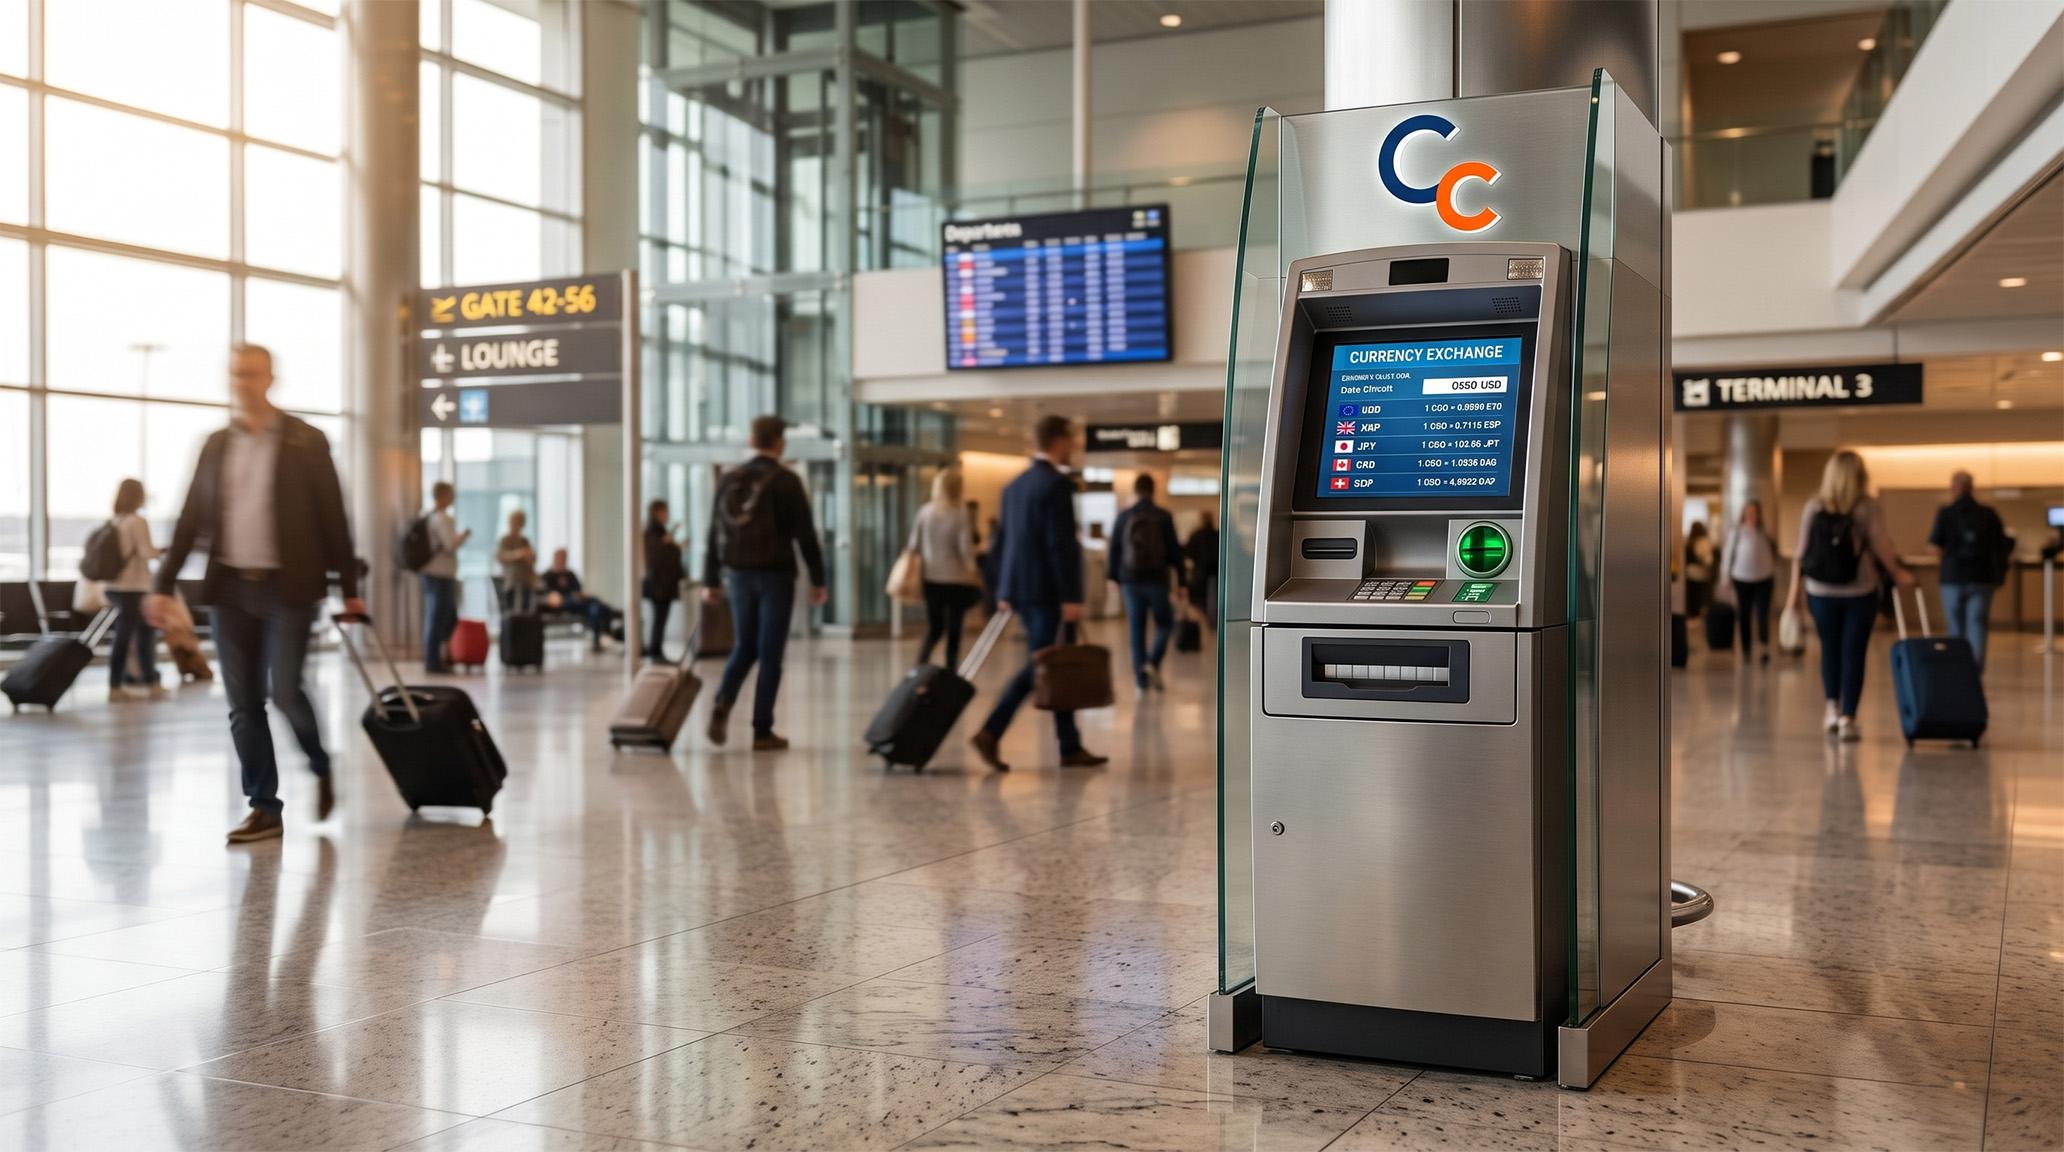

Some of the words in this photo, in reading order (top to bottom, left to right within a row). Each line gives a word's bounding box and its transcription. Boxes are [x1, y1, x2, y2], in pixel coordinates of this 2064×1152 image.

[461, 290, 523, 320] GATE
[526, 284, 597, 316] 42-56
[461, 339, 559, 371] LOUNGE
[1349, 348, 1423, 364] CURRENCY
[1427, 345, 1504, 361] EXCHANGE
[1341, 386, 1361, 394] Date
[1480, 380, 1502, 390] USD
[1716, 374, 1850, 403] TERMINAL
[1854, 373, 1873, 398] 3
[1483, 420, 1501, 429] ESP
[1353, 479, 1374, 487] SDP
